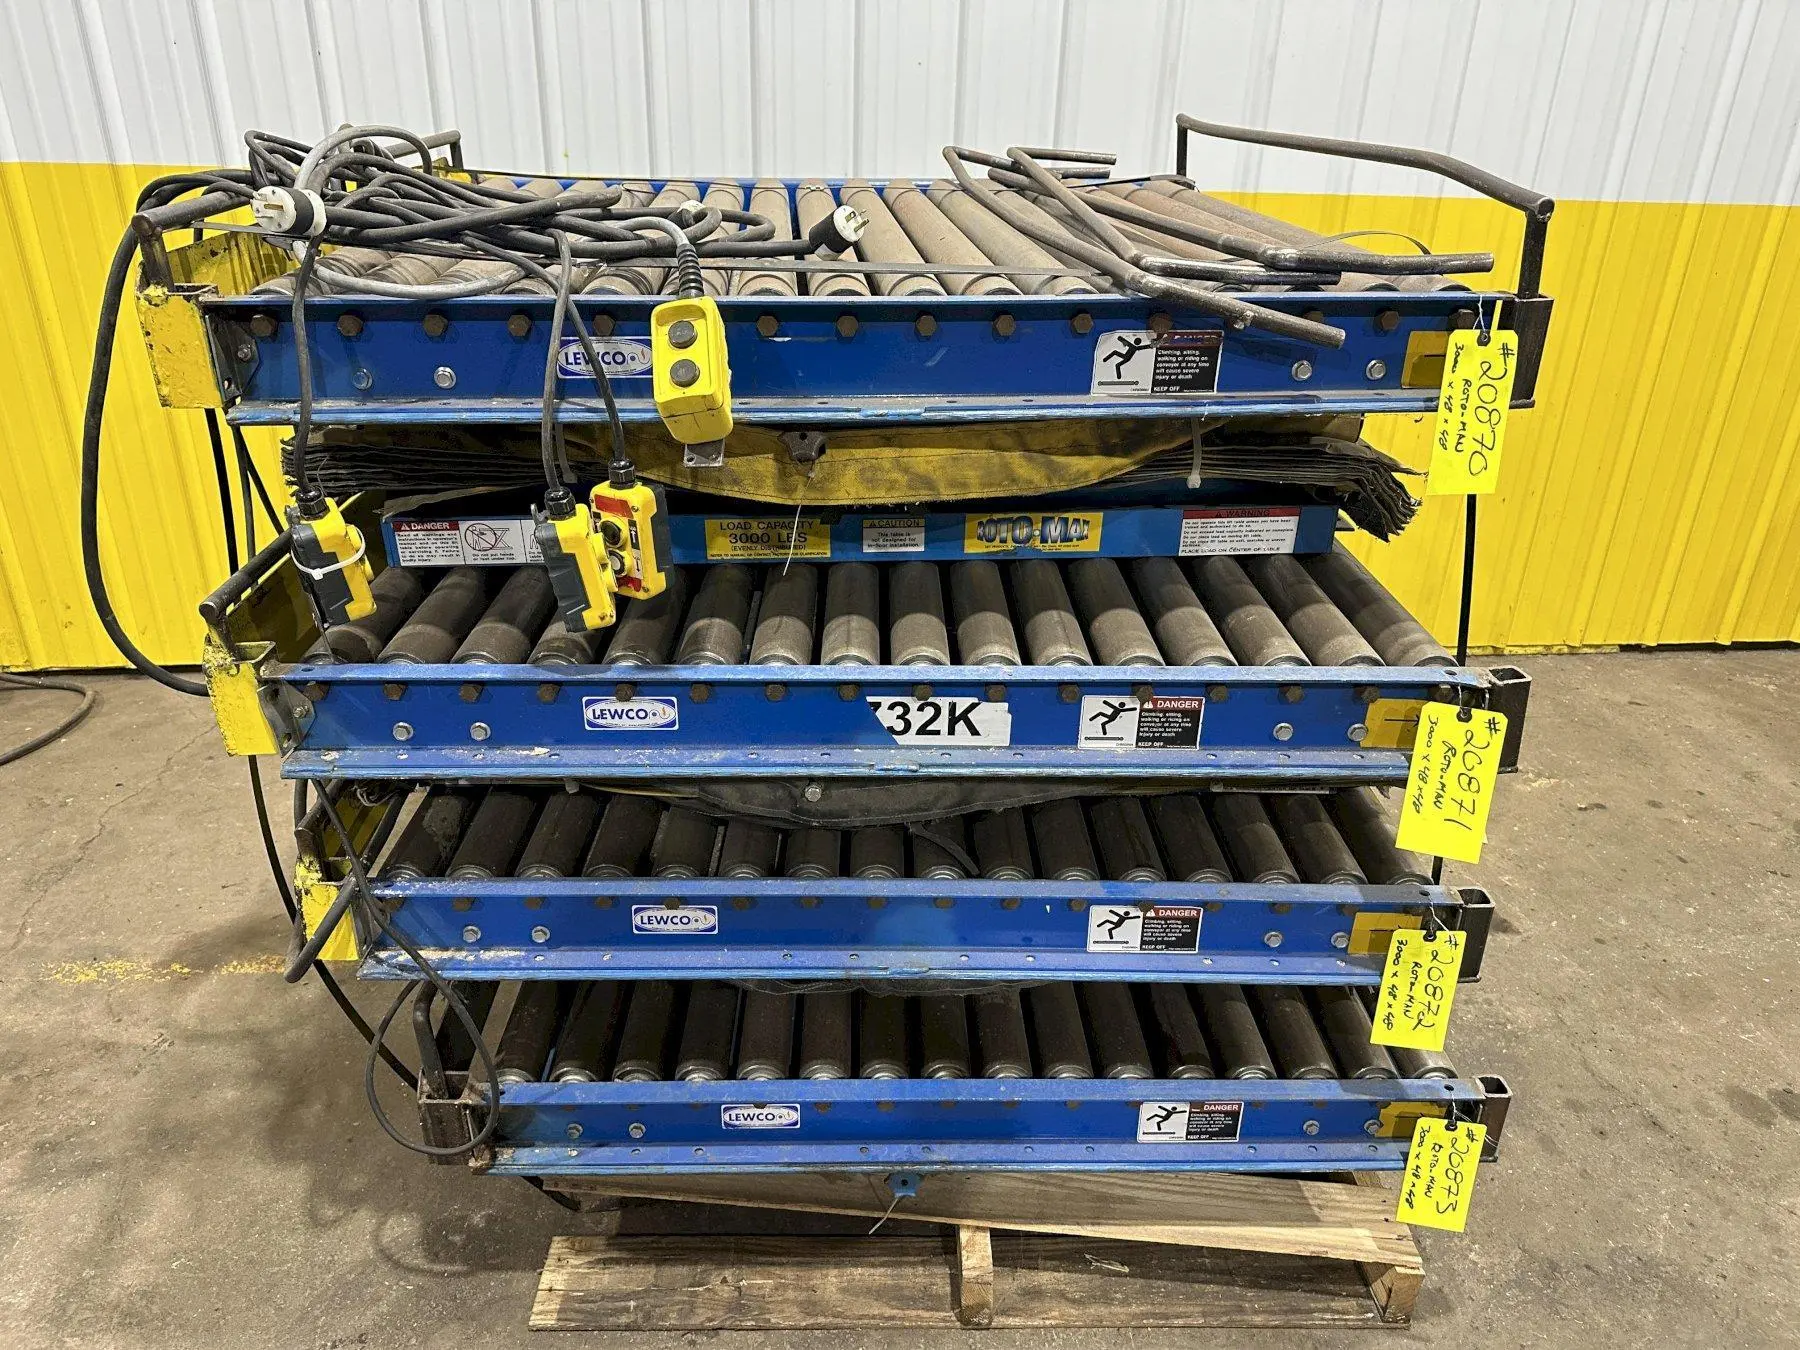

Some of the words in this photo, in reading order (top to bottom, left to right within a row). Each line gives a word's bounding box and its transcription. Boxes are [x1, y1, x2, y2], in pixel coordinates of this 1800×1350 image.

[1444, 395, 1453, 413] 48
[1439, 429, 1449, 451] 48
[1226, 509, 1270, 517] WARNING
[411, 522, 450, 531] DANGER
[720, 521, 752, 531] LOAD
[757, 520, 814, 531] CAPACITY
[878, 519, 920, 528] CAUTION
[729, 532, 770, 544] 3000
[778, 532, 808, 544] LBS
[1157, 700, 1199, 709] DANGER
[592, 708, 649, 721] LEWCO
[1418, 766, 1430, 785] 48
[1159, 909, 1198, 917] DANGER
[640, 915, 691, 926] LEWCO
[1393, 939, 1408, 966] 3000
[1383, 1012, 1395, 1031] 48
[729, 1112, 776, 1122] LEWCO
